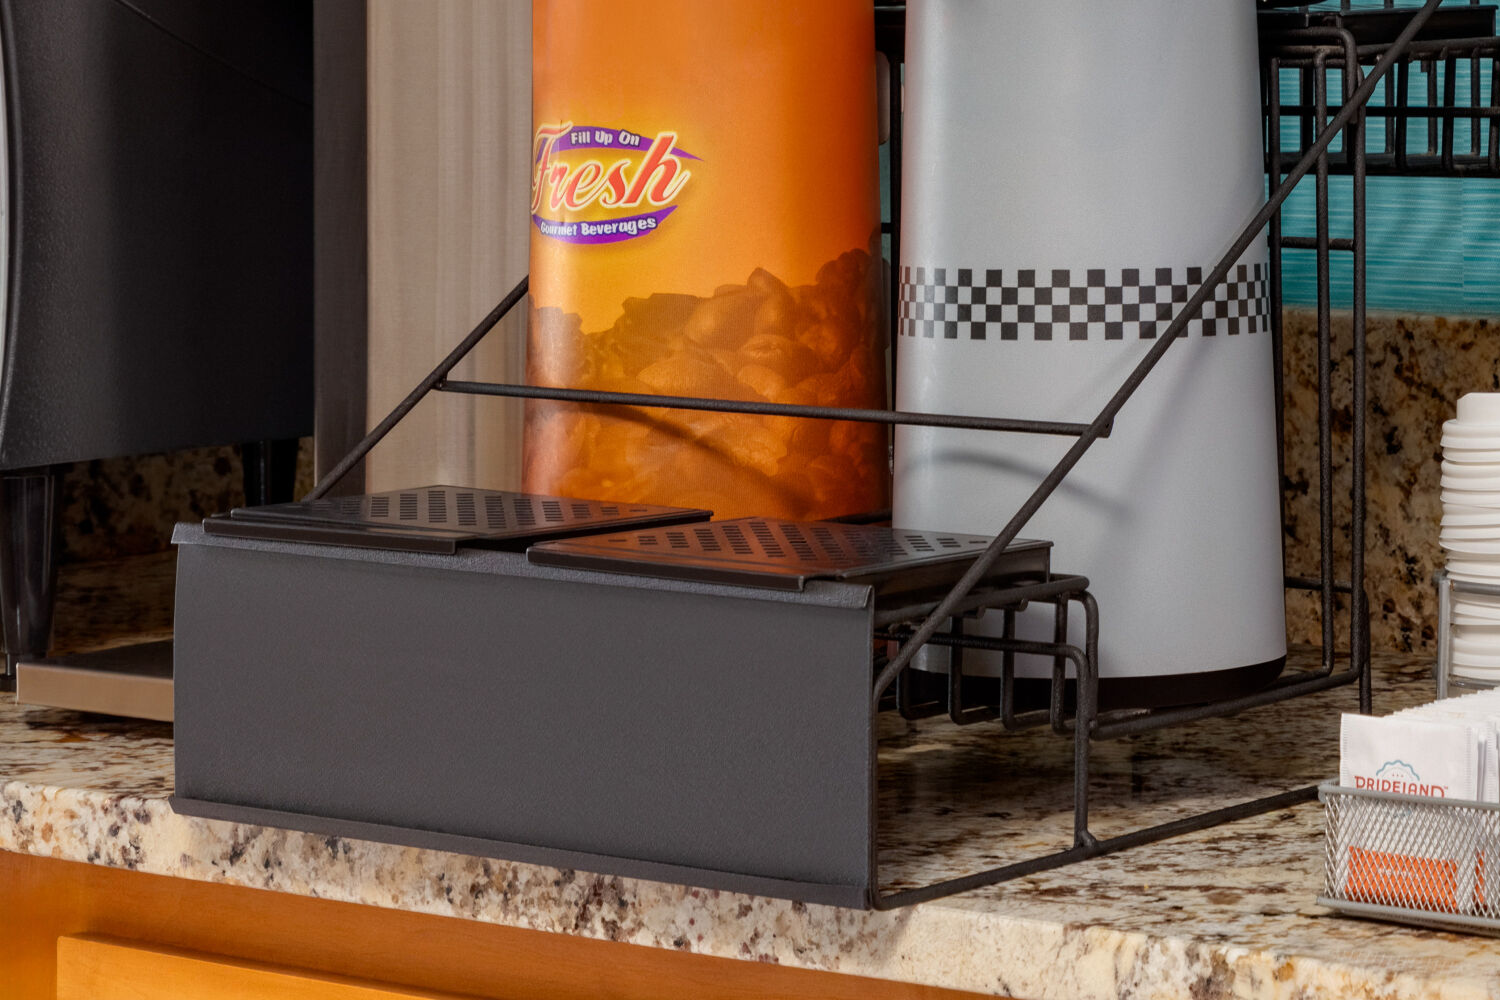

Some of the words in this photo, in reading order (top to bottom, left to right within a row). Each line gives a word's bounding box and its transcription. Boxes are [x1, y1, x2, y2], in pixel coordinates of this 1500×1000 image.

[570, 130, 591, 145] Fill
[594, 130, 613, 146] Up
[618, 129, 641, 147] On
[531, 121, 691, 215] Fresh
[540, 221, 577, 236] Gourmet
[580, 217, 657, 236] Beverages
